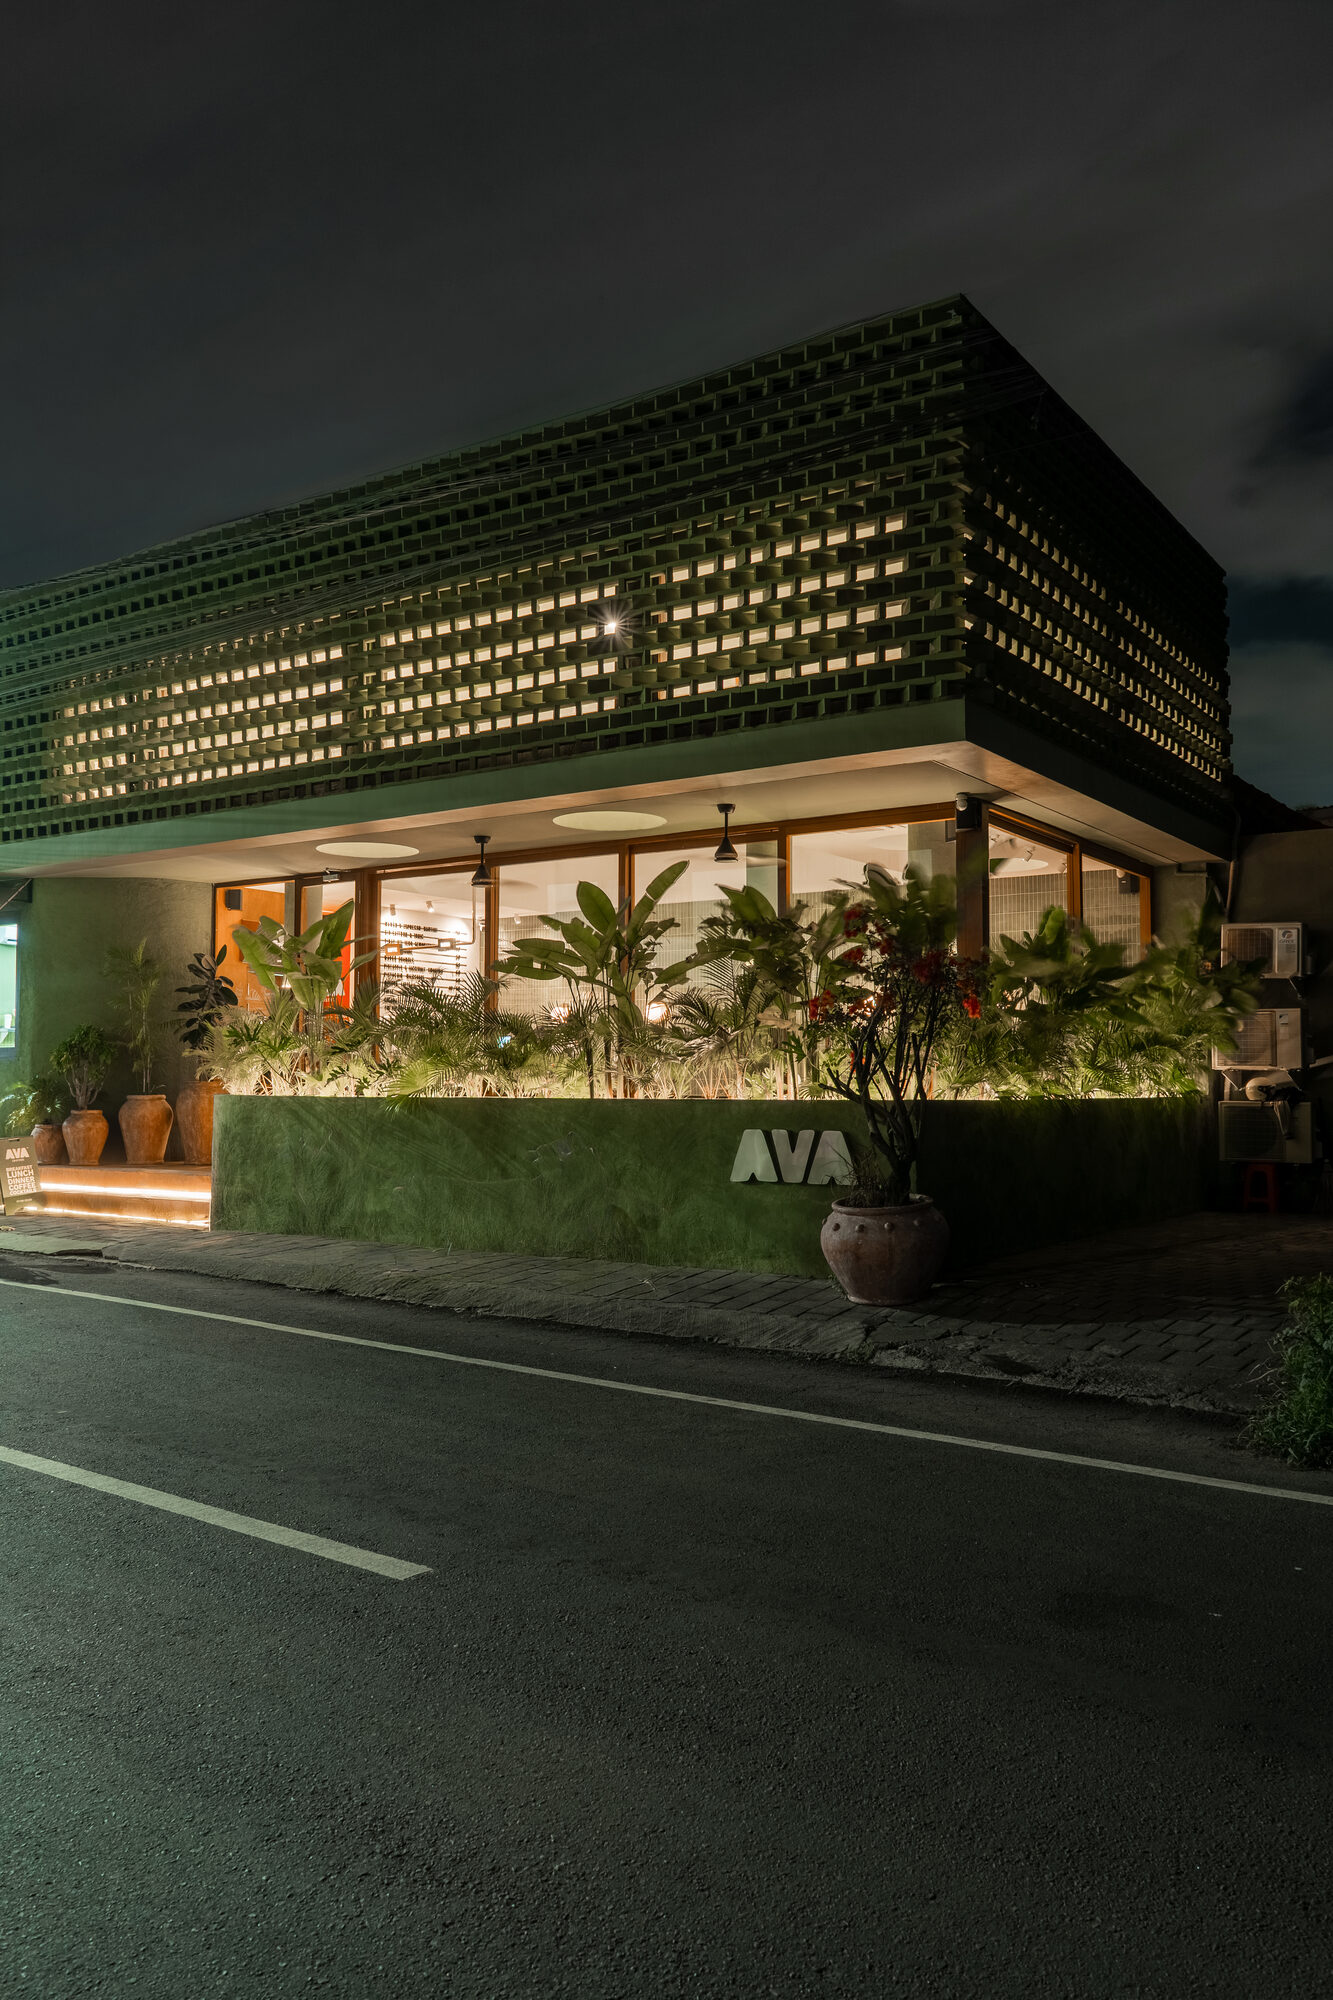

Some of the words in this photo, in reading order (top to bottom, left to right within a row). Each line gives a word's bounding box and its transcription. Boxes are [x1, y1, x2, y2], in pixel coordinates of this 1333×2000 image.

[5, 1148, 30, 1160] AVA
[729, 1128, 858, 1185] AVA
[7, 1169, 34, 1178] LUNCH
[8, 1176, 35, 1184] DINNER
[9, 1182, 36, 1191] COFFEE
